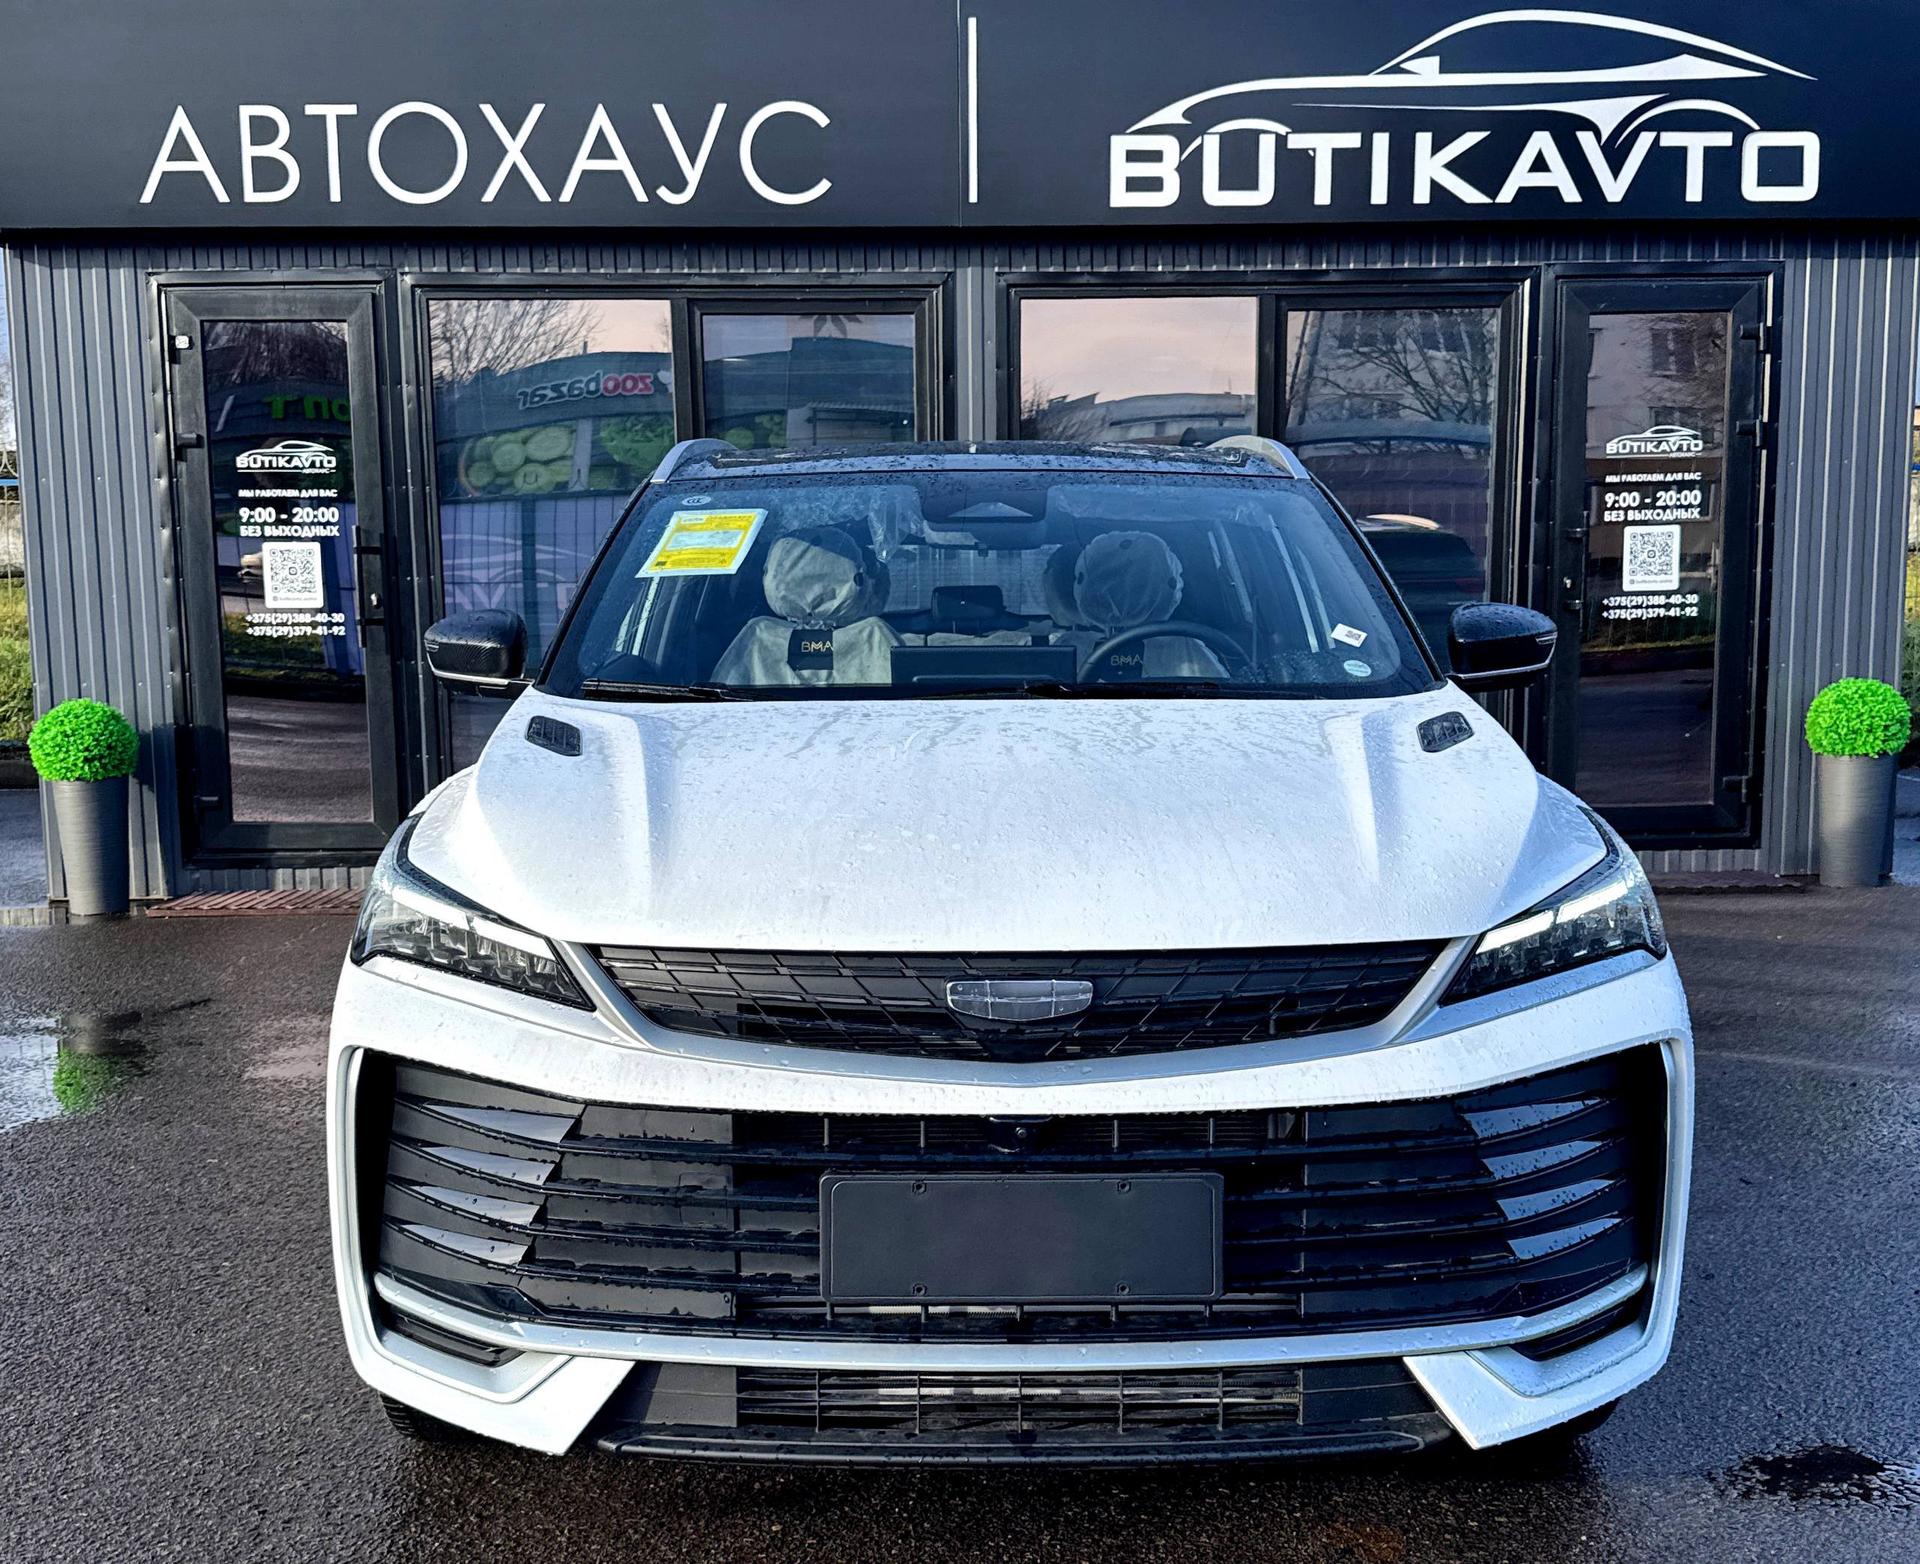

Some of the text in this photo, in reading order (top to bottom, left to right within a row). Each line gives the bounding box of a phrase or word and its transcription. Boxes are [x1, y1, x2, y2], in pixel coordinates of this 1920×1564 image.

[140, 100, 833, 205] АВТОХАУС
[1109, 130, 1821, 208] BUTIKAVTO
[1606, 440, 1703, 454] BUTIKAVTO
[236, 455, 337, 468] BUTIKAVTO
[1621, 473, 1665, 482] РАБОТАЕМ
[1665, 472, 1683, 481] ДЛЯ
[1683, 472, 1702, 480] ВАС
[255, 489, 300, 497] РАБОТАЕМ
[300, 489, 319, 498] ДЛЯ
[319, 489, 338, 497] ВАС
[1604, 491, 1640, 508] 9:00
[1655, 489, 1702, 507] 20:00
[238, 507, 276, 523] 9:00
[291, 506, 340, 523] 20:00
[1603, 507, 1701, 522] БЕЗ ВЫХОДНЫХ
[240, 525, 340, 537] БЕЗ ВЫХОДНЫХ
